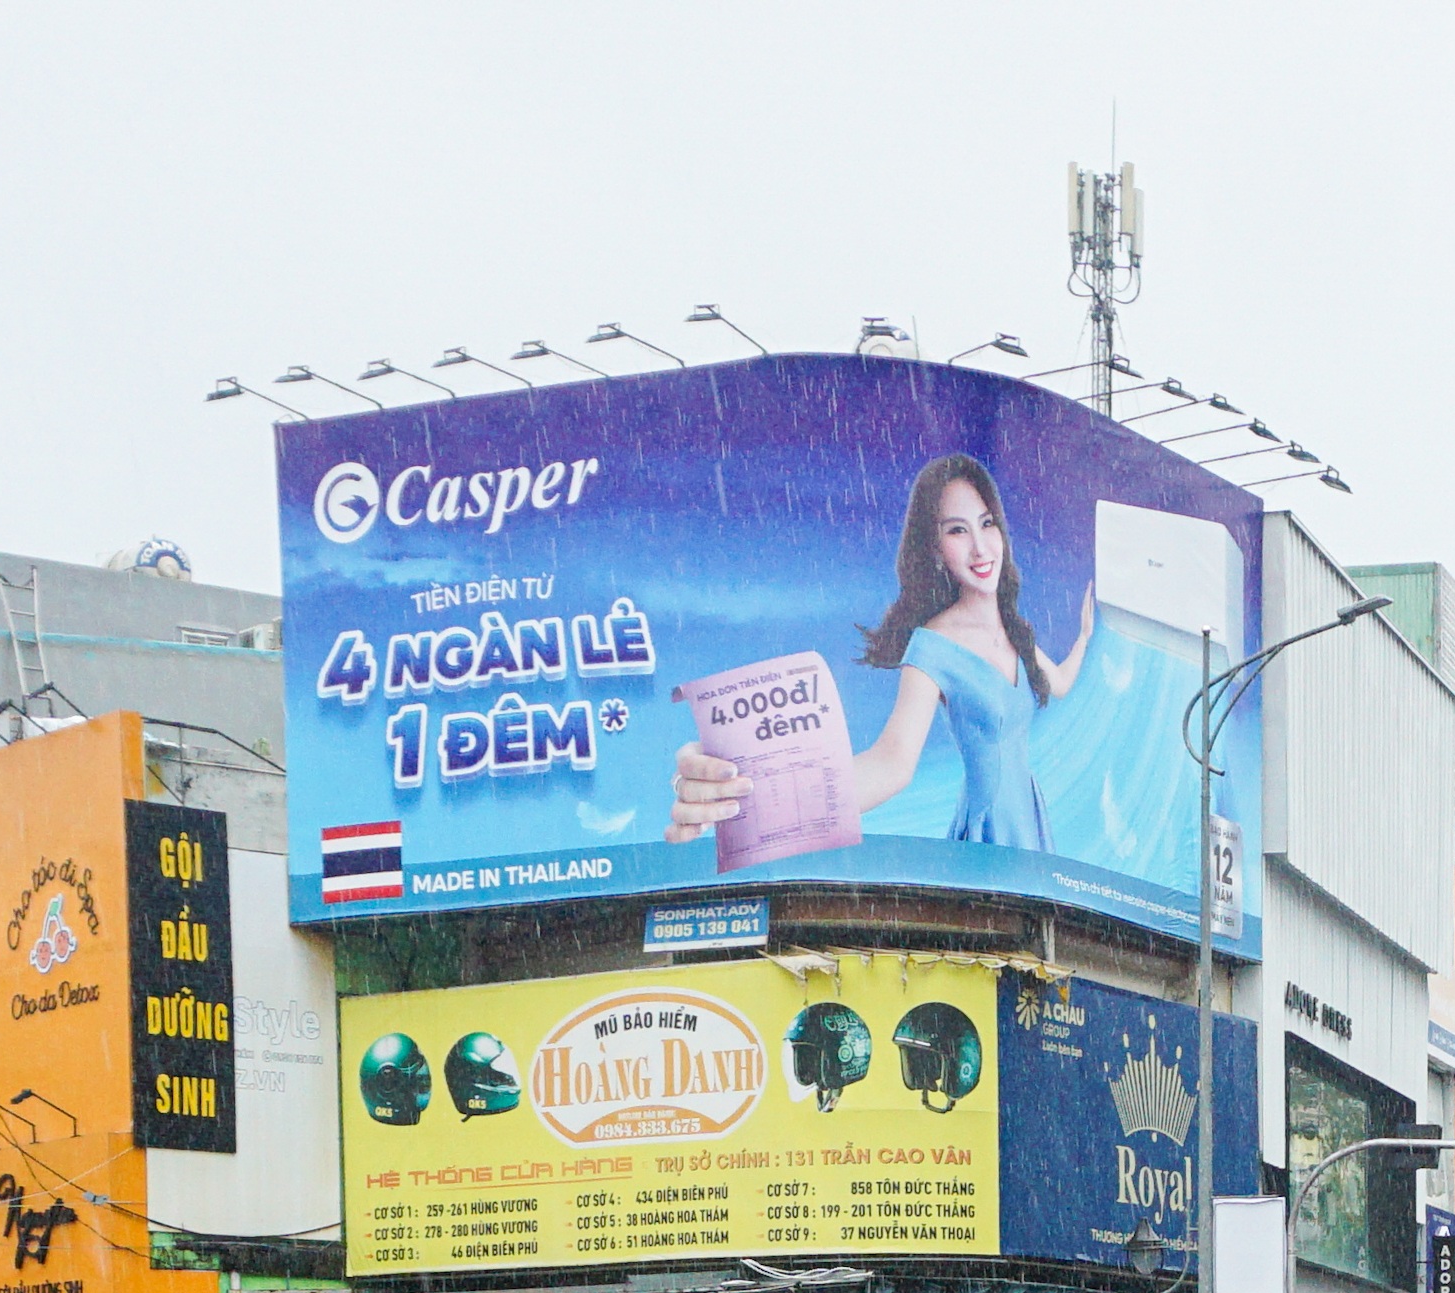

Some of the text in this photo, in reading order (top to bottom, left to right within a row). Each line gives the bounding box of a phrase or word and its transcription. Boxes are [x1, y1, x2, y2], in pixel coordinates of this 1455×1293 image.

[386, 457, 599, 536] Casper
[410, 573, 556, 615] TIỀN ĐIỆN TỪ
[317, 597, 656, 706] 4 NGÀN LẺ
[386, 701, 429, 789] 1
[158, 832, 204, 889] GỘI
[412, 857, 613, 895] MADE IN THAILAND
[1213, 844, 1233, 885] 12
[653, 903, 761, 922] SONPHAT.ADV
[653, 918, 760, 939] 0905 139 041
[161, 904, 209, 962] ĐẦU
[147, 986, 229, 1042] DƯỠNG
[593, 1006, 698, 1041] MŨ BẢO HIỂM
[1043, 1022, 1071, 1039] GROUP
[541, 1037, 755, 1108] HOÀNG DANH
[155, 1073, 217, 1118] SINH
[594, 1117, 701, 1139] 0984.333.675
[366, 1141, 972, 1189] HỆ THỐNG CỬA HÀNG TRỤ SỞ CHÍNH 131 TRẦN CAO VÂN
[635, 1191, 653, 1205] 434
[655, 1185, 679, 1204] ĐIỆN
[681, 1184, 705, 1201] BIÊN
[850, 1175, 976, 1197] 858 TÔN ĐỨC THẮNG
[1115, 1144, 1194, 1226] Royal
[426, 1197, 538, 1217] 259 HÙNG VƯƠNG
[626, 1205, 729, 1227] 38 HOÀNG HOA THÁM
[820, 1199, 976, 1219] 199 201 TÔN ĐỨC THẮNG
[424, 1218, 538, 1238] 278 280 HÙNG VƯƠNG
[626, 1228, 729, 1249] 51 HOÀNG HOA THÁM
[840, 1220, 976, 1243] 37 NGUYỄN VĂN THOẠI
[451, 1244, 463, 1259] 46
[465, 1243, 489, 1259] ĐIỆN
[491, 1241, 515, 1256] BIÊN
